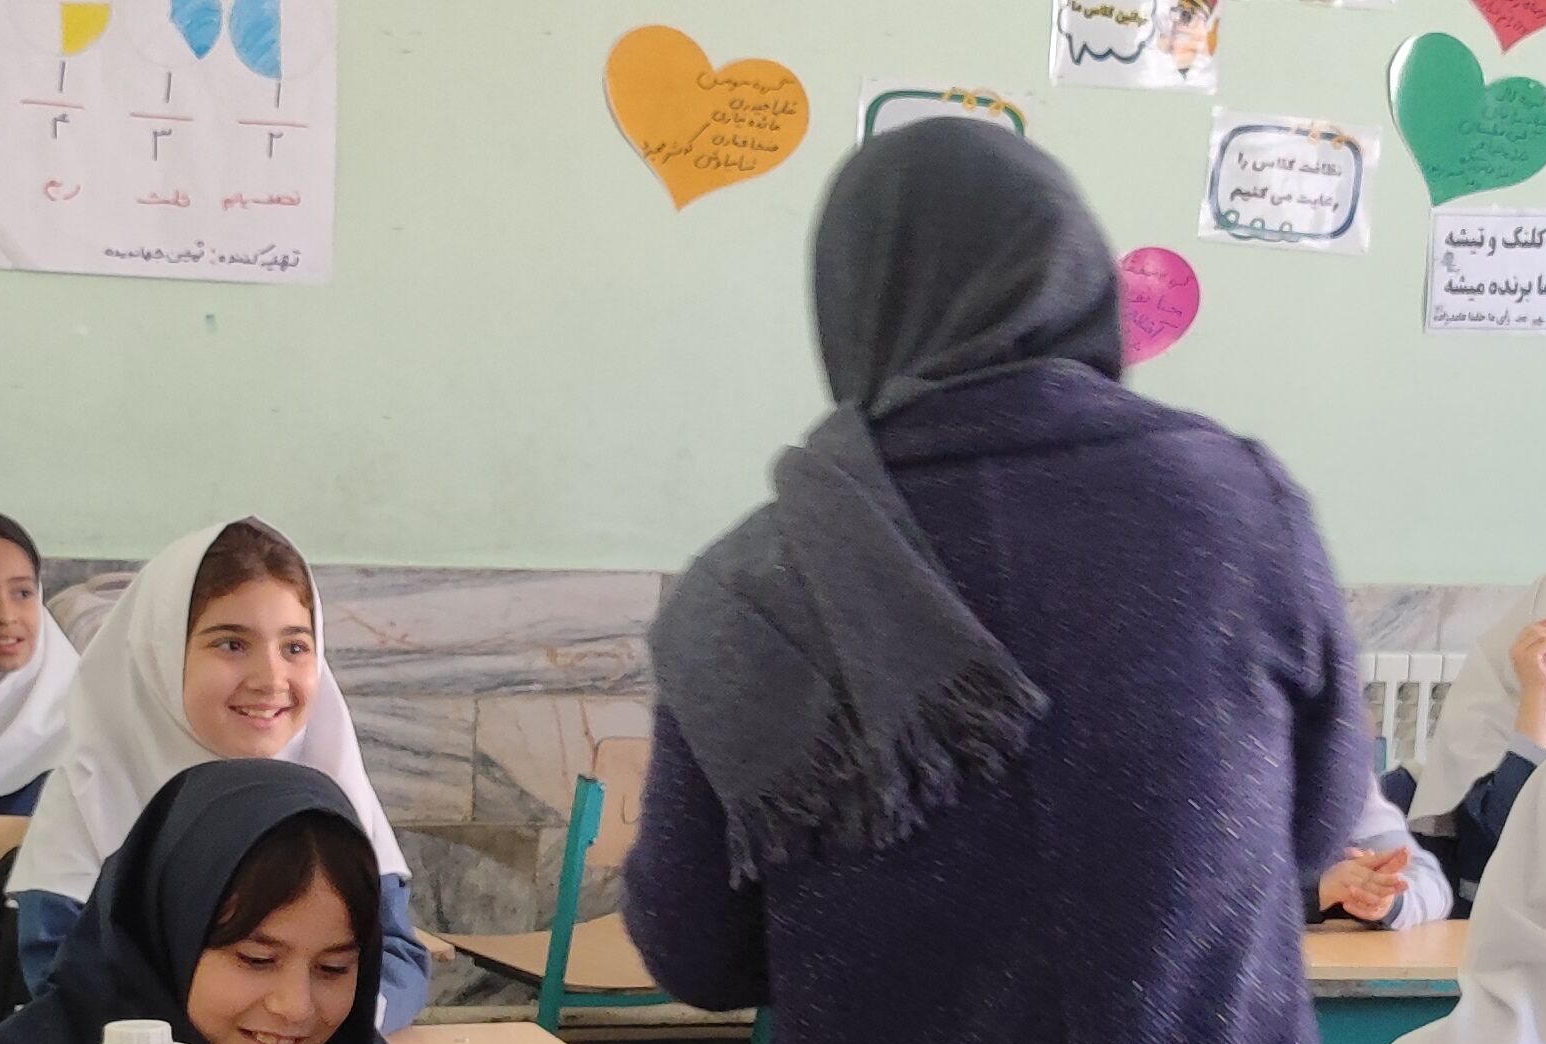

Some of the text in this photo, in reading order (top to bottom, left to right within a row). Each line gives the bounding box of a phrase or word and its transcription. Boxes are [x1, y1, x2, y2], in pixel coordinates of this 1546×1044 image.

[1444, 226, 1486, 255] تیشه
[1443, 275, 1486, 302] میشه
[1487, 275, 1533, 303] برنده
